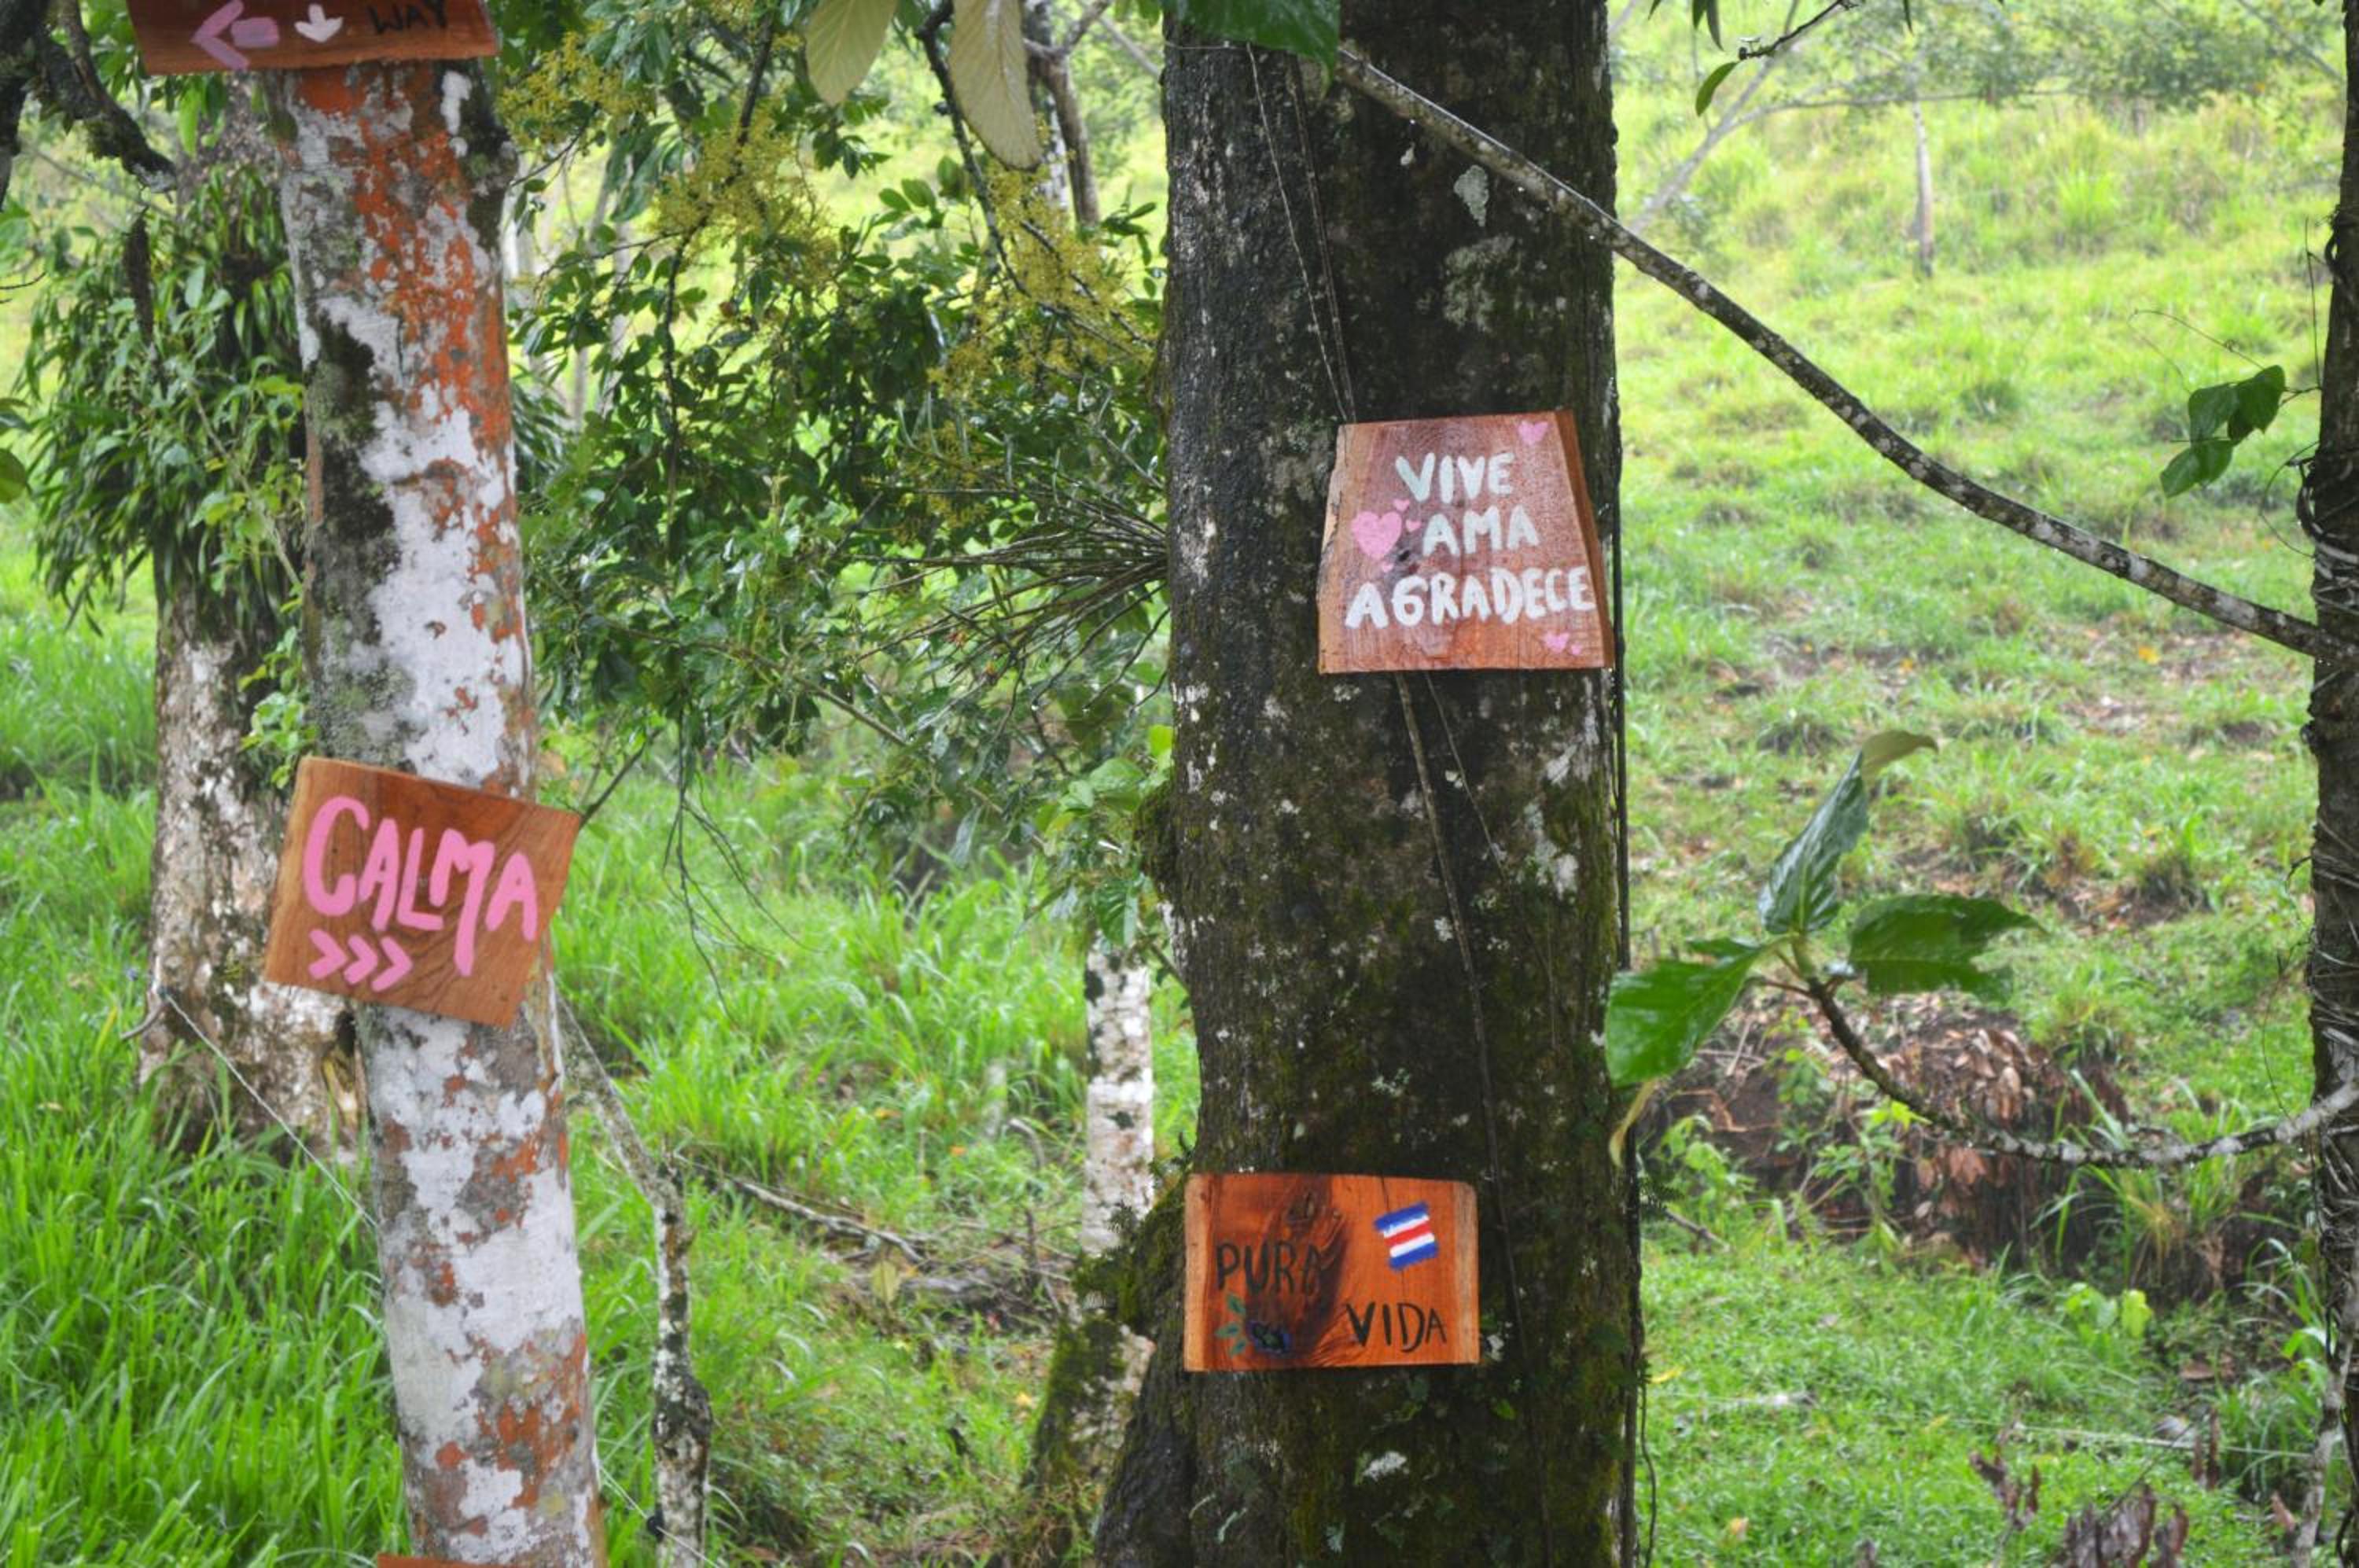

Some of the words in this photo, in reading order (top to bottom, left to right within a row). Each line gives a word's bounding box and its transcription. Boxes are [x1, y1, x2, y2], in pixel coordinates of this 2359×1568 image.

[366, 0, 447, 34] WAY
[1395, 452, 1514, 503] VIVE
[1422, 504, 1540, 555] AMA
[1345, 565, 1596, 628] AGRADECE
[303, 796, 538, 977] CALMA
[1216, 1240, 1324, 1294] PURA
[1345, 1301, 1447, 1353] VIDA
